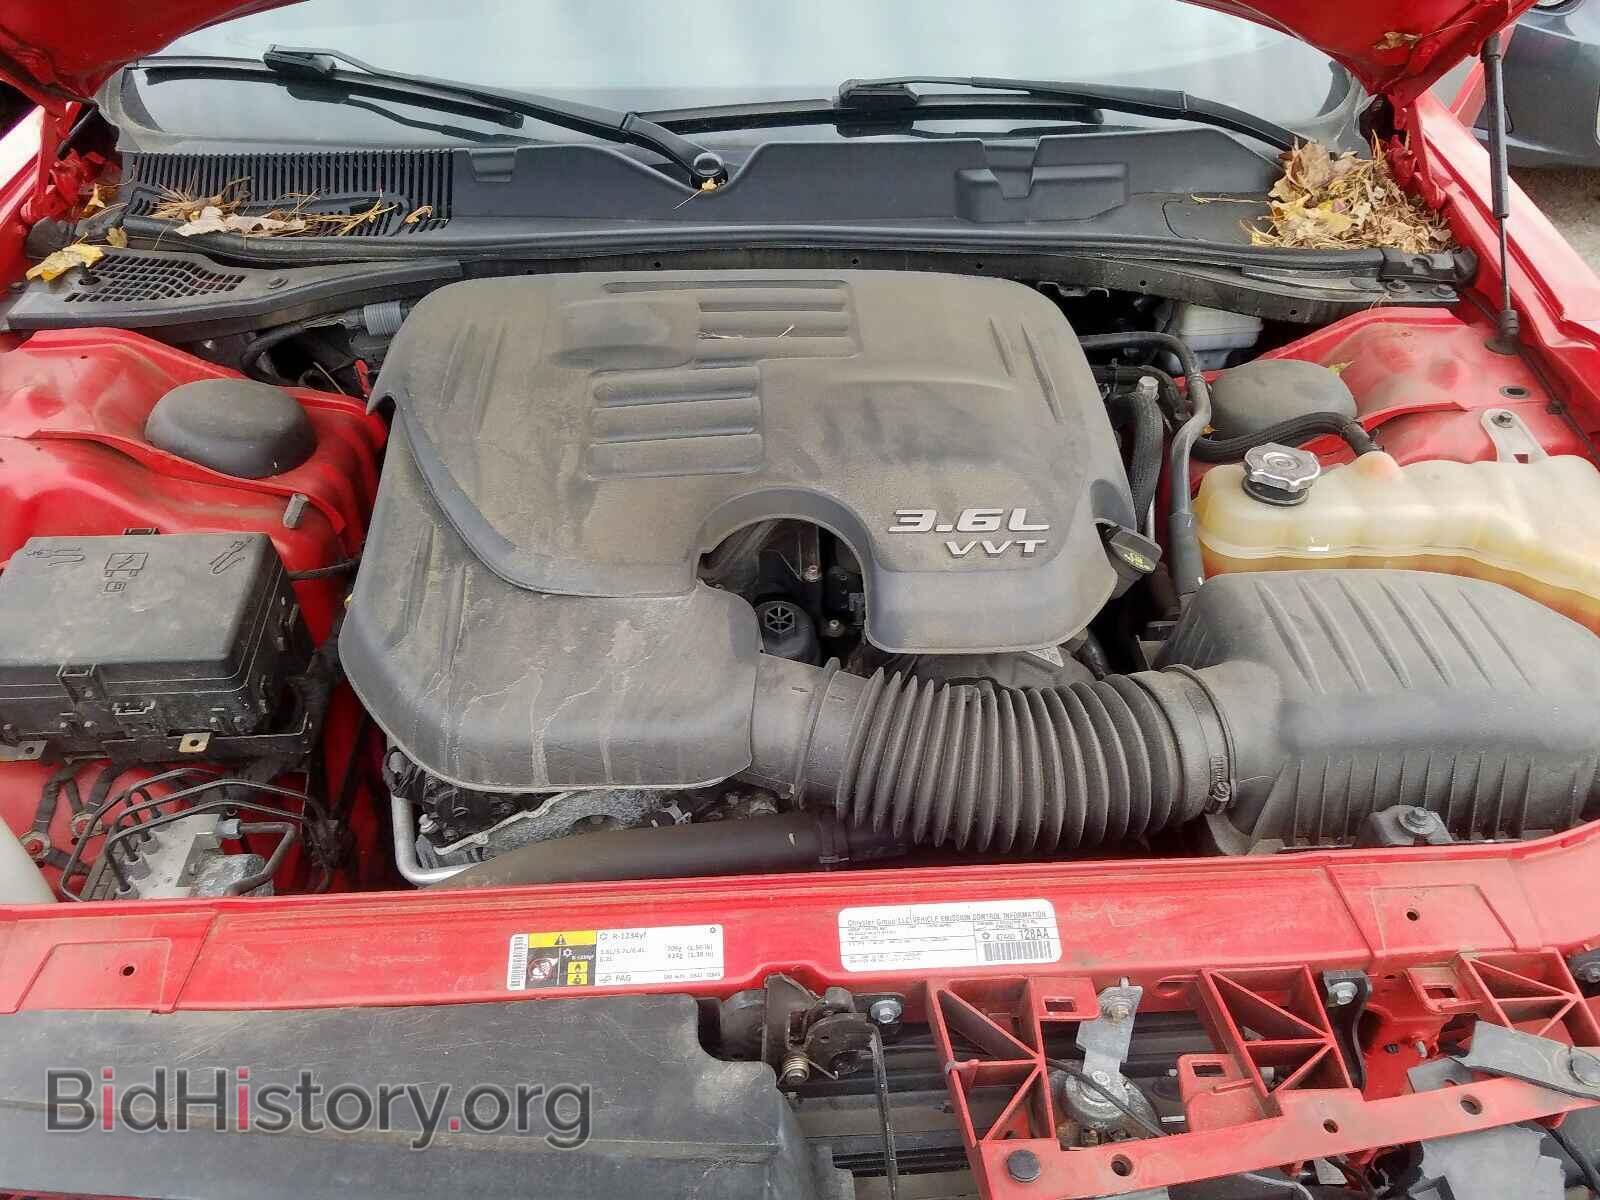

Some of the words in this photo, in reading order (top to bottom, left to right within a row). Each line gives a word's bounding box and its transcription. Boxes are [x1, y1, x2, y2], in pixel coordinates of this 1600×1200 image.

[888, 508, 1050, 532] 3.6L
[944, 539, 1048, 558] VVT
[972, 912, 1001, 921] CONTROL
[1003, 910, 1047, 920] INFORMATION
[1019, 927, 1050, 940] 128AA
[615, 974, 632, 982] PAG
